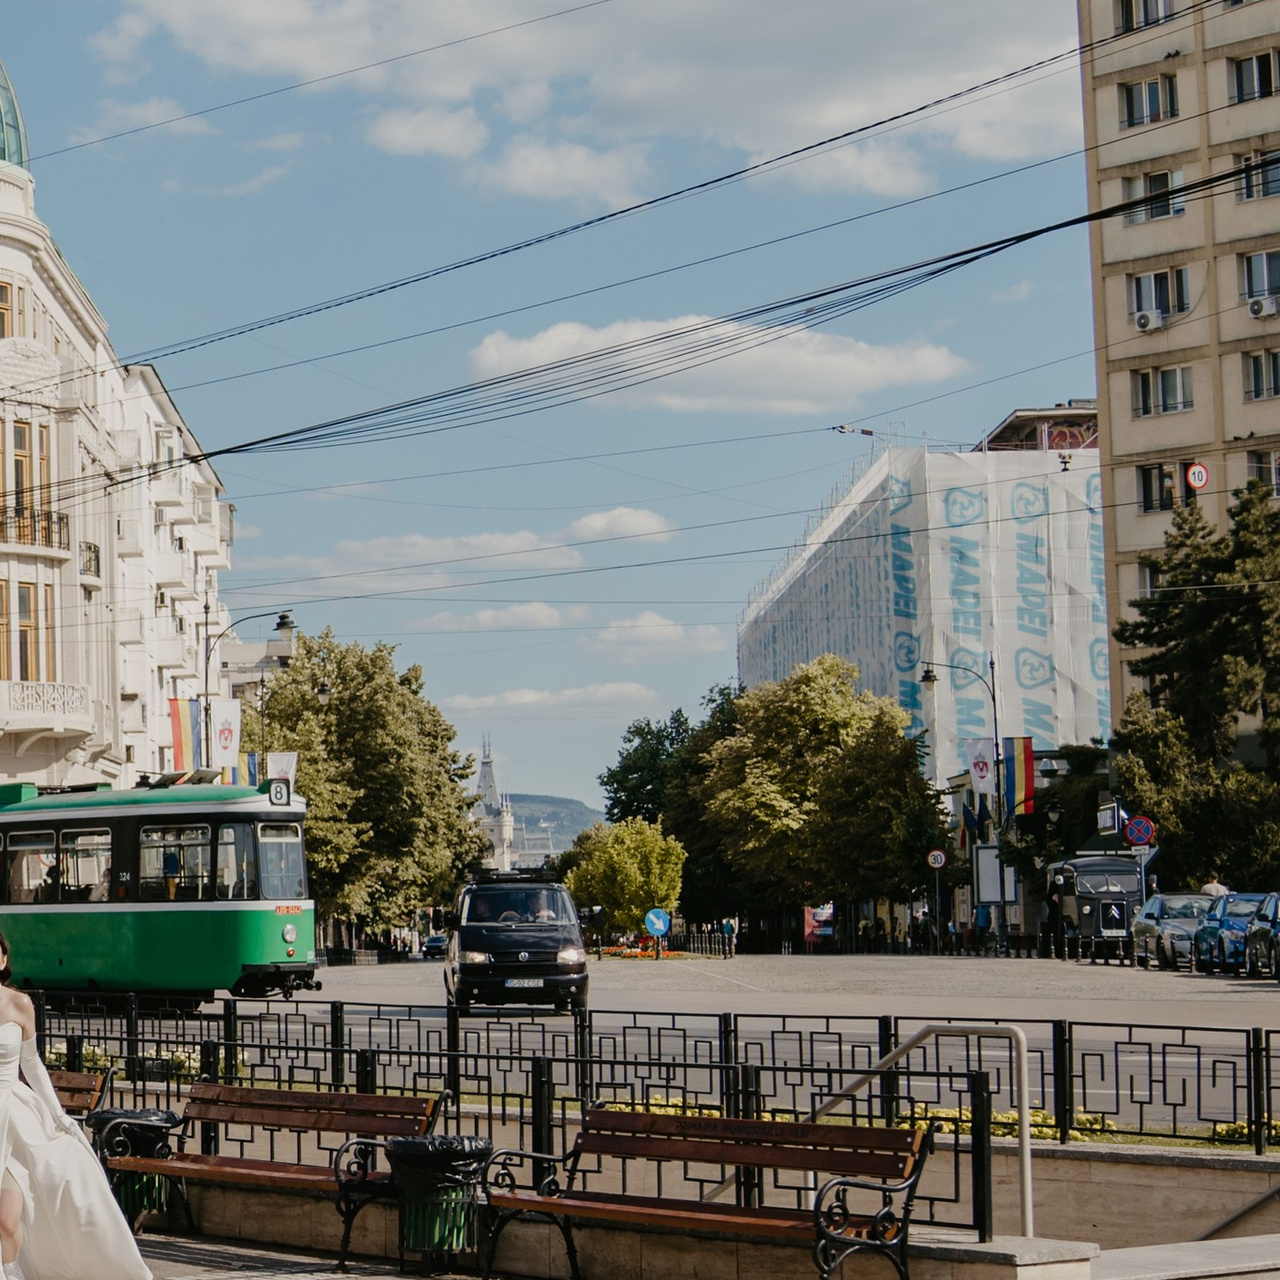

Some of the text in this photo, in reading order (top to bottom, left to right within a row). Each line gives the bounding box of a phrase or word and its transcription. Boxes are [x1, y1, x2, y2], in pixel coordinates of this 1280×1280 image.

[1192, 470, 1203, 482] 10
[890, 522, 918, 621] MAPEI
[949, 535, 983, 639] MAPEI
[1015, 531, 1049, 638] MAPEI
[274, 784, 283, 801] 8
[930, 854, 943, 865] 30
[119, 872, 131, 881] 324
